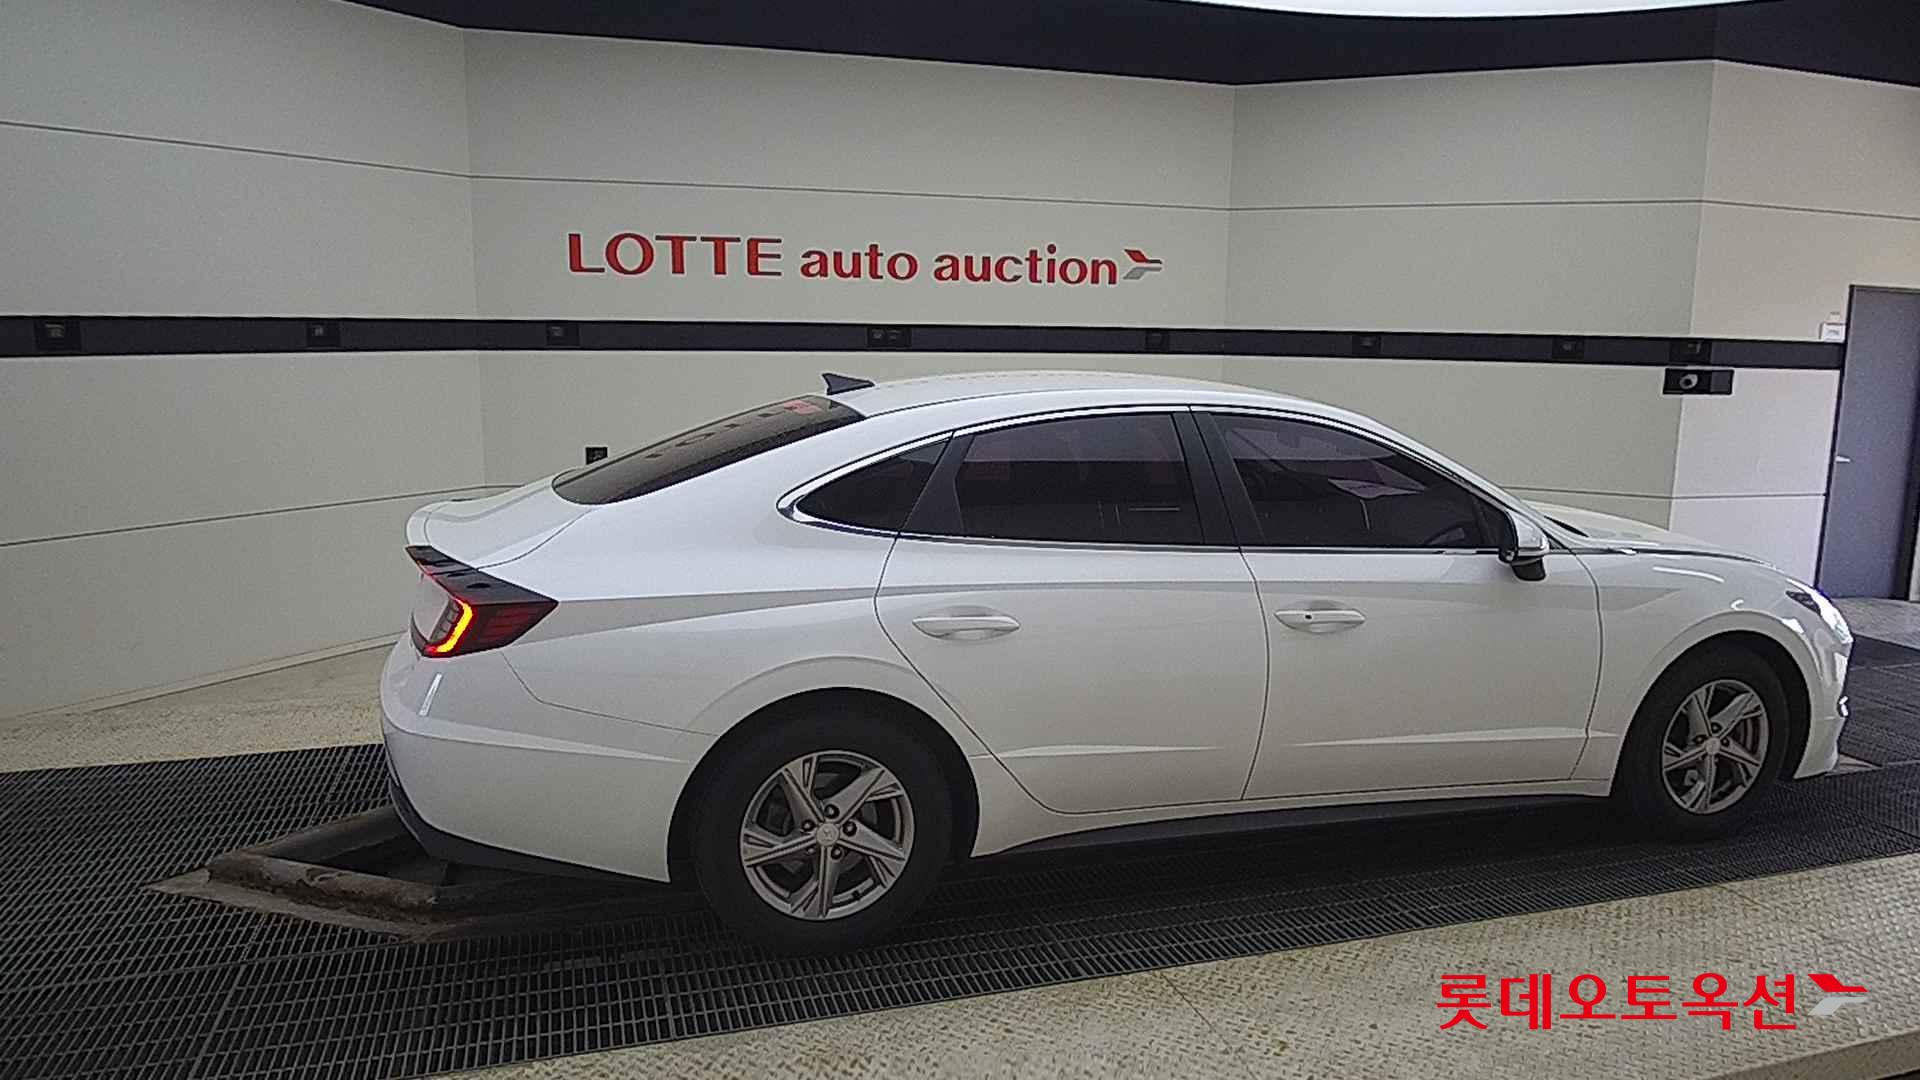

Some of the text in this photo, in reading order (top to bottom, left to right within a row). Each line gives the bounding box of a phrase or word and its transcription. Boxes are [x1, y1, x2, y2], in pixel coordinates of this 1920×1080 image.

[568, 232, 1118, 285] LOTTE auto auction
